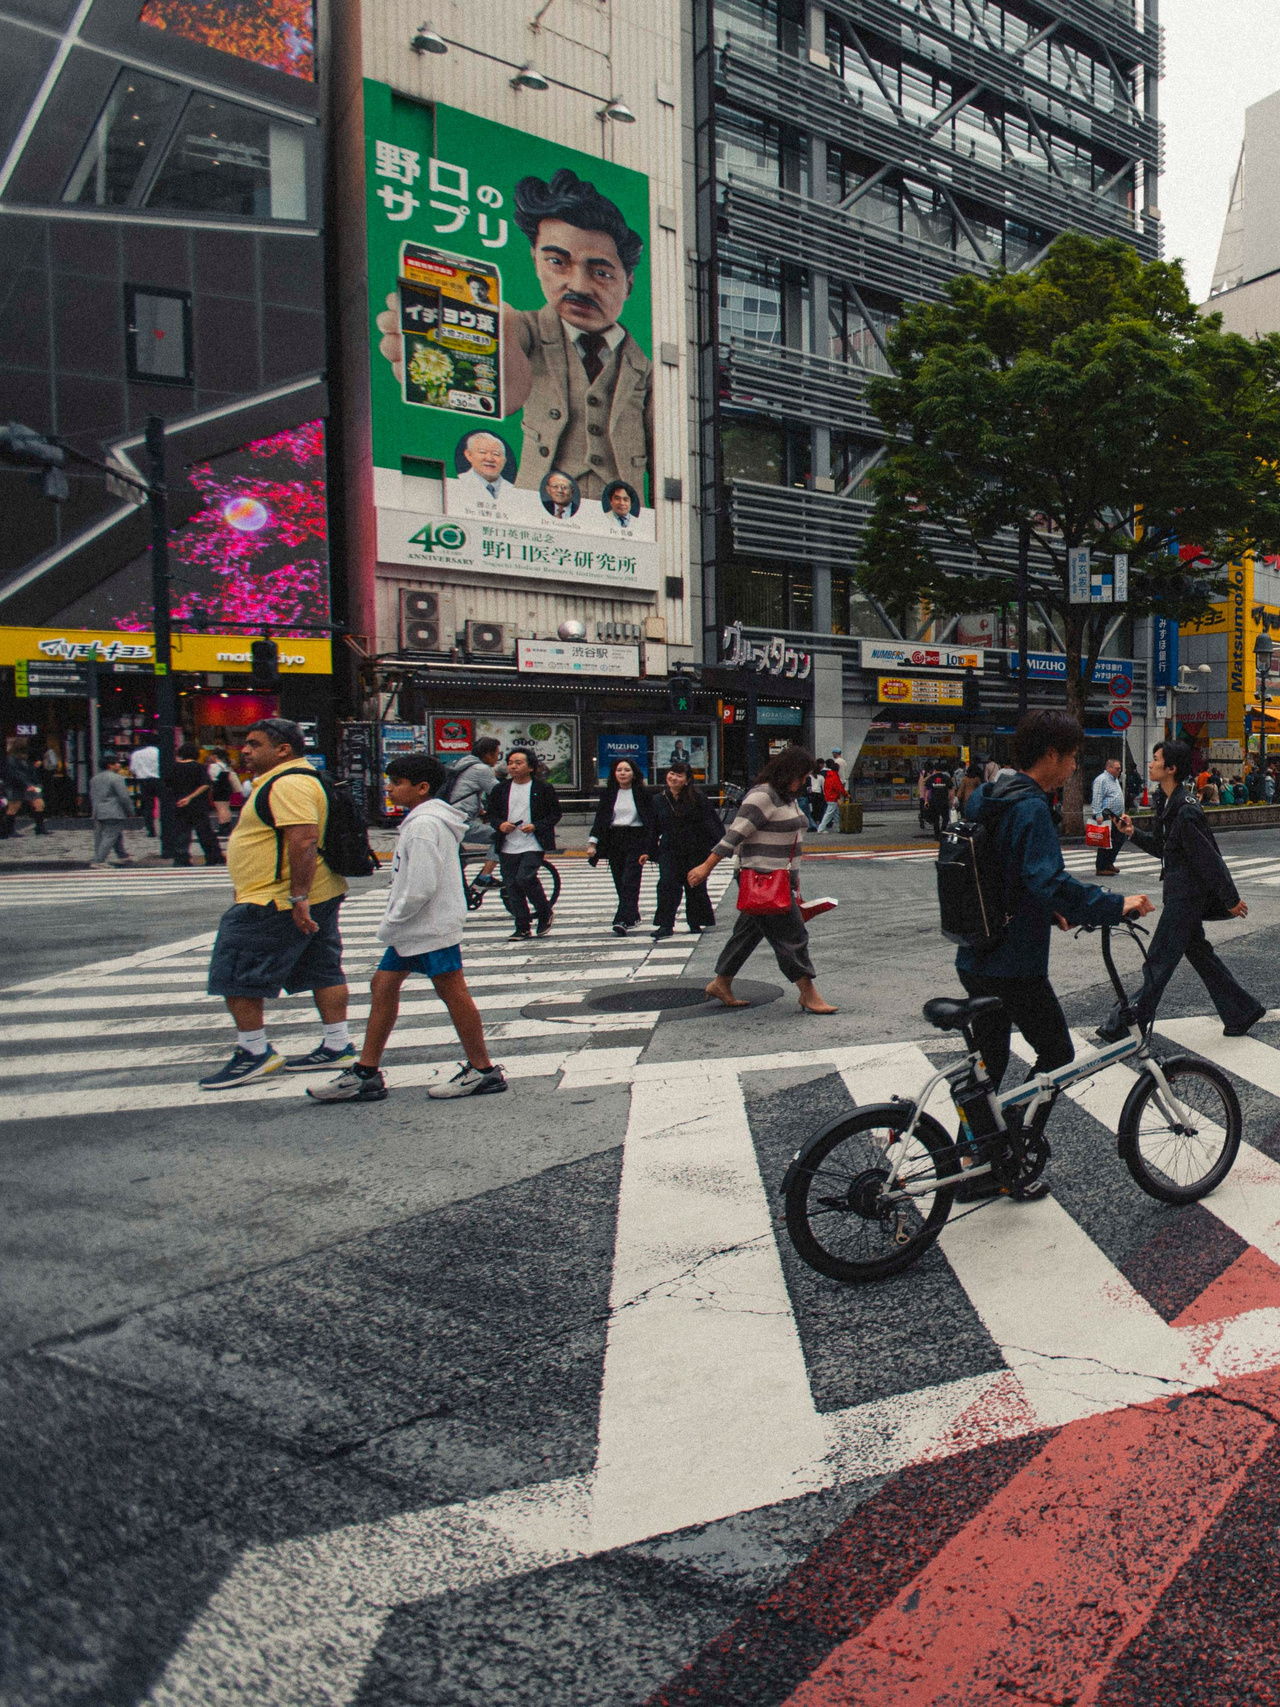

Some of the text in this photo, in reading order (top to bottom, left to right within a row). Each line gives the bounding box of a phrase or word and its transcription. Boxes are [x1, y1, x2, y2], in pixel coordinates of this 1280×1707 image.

[375, 139, 504, 209] 野口の
[376, 184, 508, 249] サプリ
[408, 521, 467, 553] 40
[482, 526, 556, 544] 野口英世記念
[408, 552, 475, 566] ANNIVERSARY
[482, 539, 637, 575] 野口医学研究所
[1079, 552, 1088, 599] 道玄坂下
[1232, 571, 1244, 692] Matsumoto
[571, 646, 609, 659] 渋谷駅
[722, 619, 811, 680] グルメタウン
[871, 648, 906, 661] NUMBERS
[946, 653, 965, 667] LOTO
[1158, 618, 1167, 672] みずほ銀行
[217, 651, 306, 666] matiyo
[1027, 658, 1067, 672] MIZUHO
[1095, 662, 1123, 671] みずほ銀行
[607, 742, 640, 750] MIZUHO
